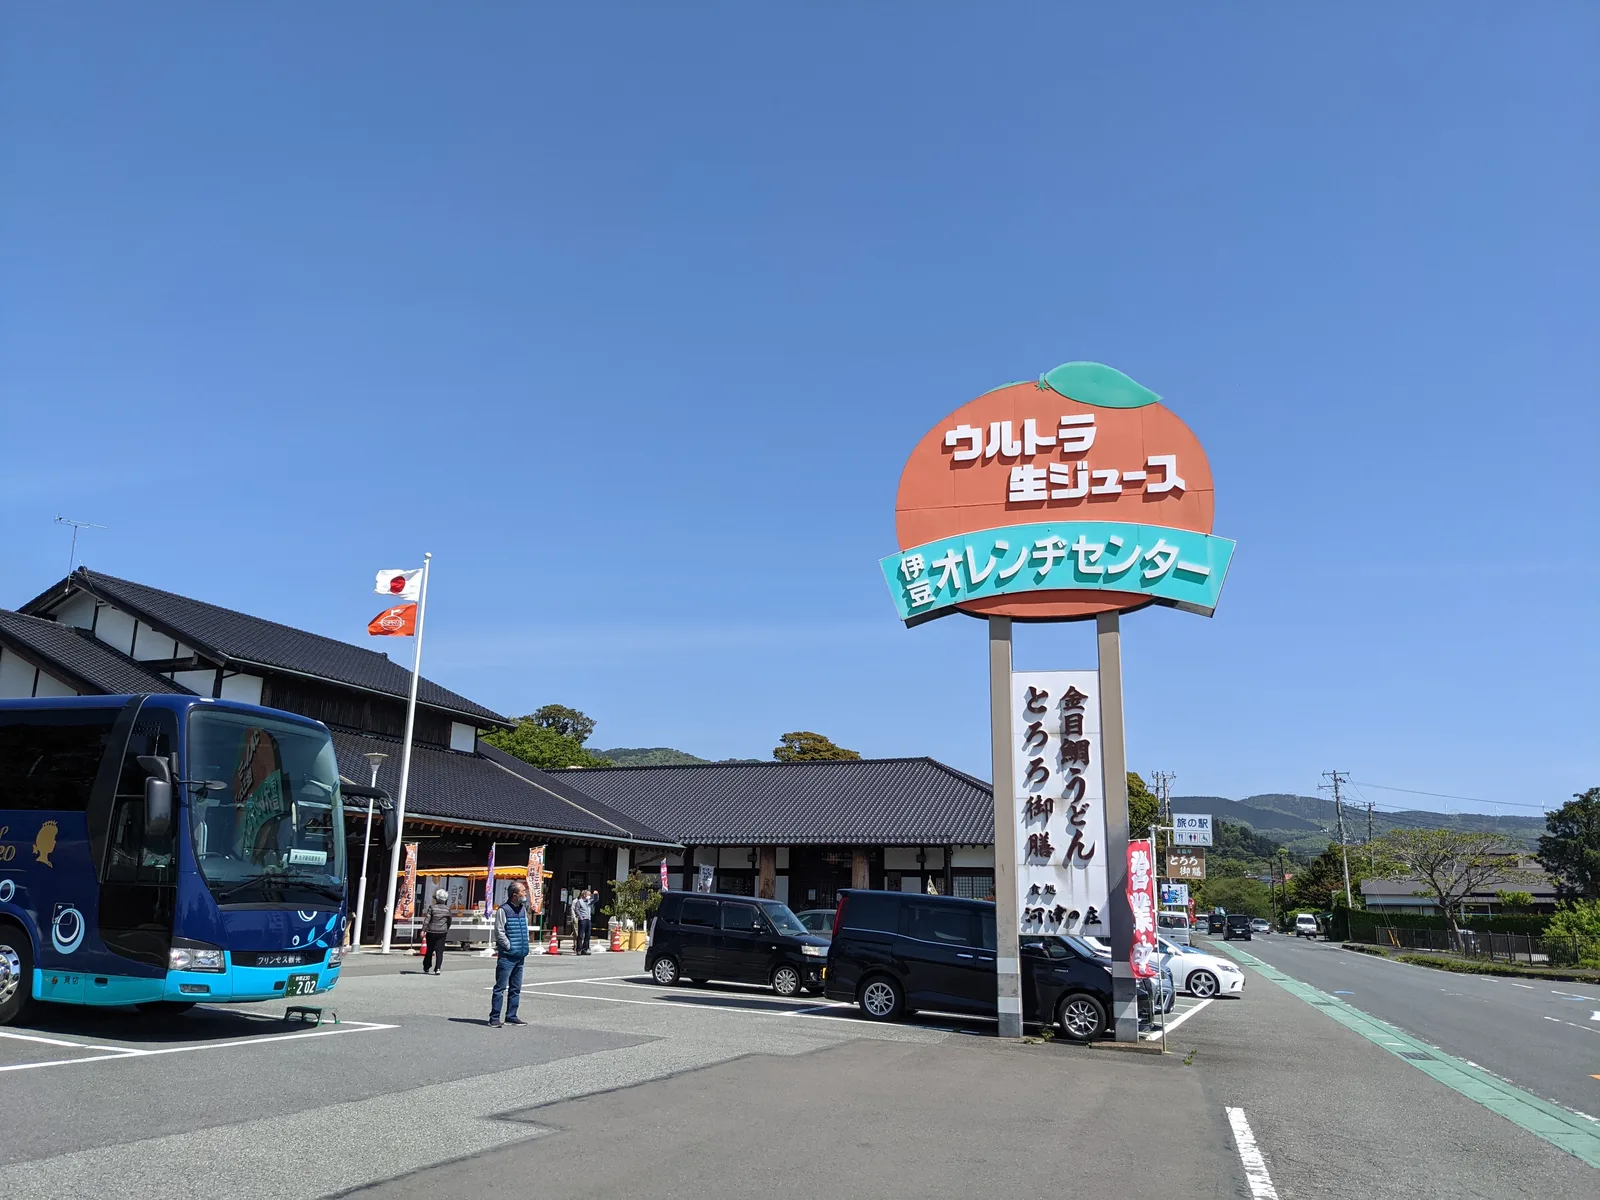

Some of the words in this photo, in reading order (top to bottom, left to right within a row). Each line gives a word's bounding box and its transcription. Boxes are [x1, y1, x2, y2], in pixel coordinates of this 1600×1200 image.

[945, 413, 1097, 461] ウルトラ
[1008, 454, 1186, 502] 生ジュース
[899, 553, 936, 608] 伊豆
[1025, 685, 1055, 859] とろろ御膳
[1059, 685, 1096, 861] 金目鯛うどん
[1176, 817, 1209, 829] 旅の駅
[1169, 854, 1198, 866] とろろ
[1030, 883, 1057, 896] 食処
[258, 955, 302, 965] プリンセス観光
